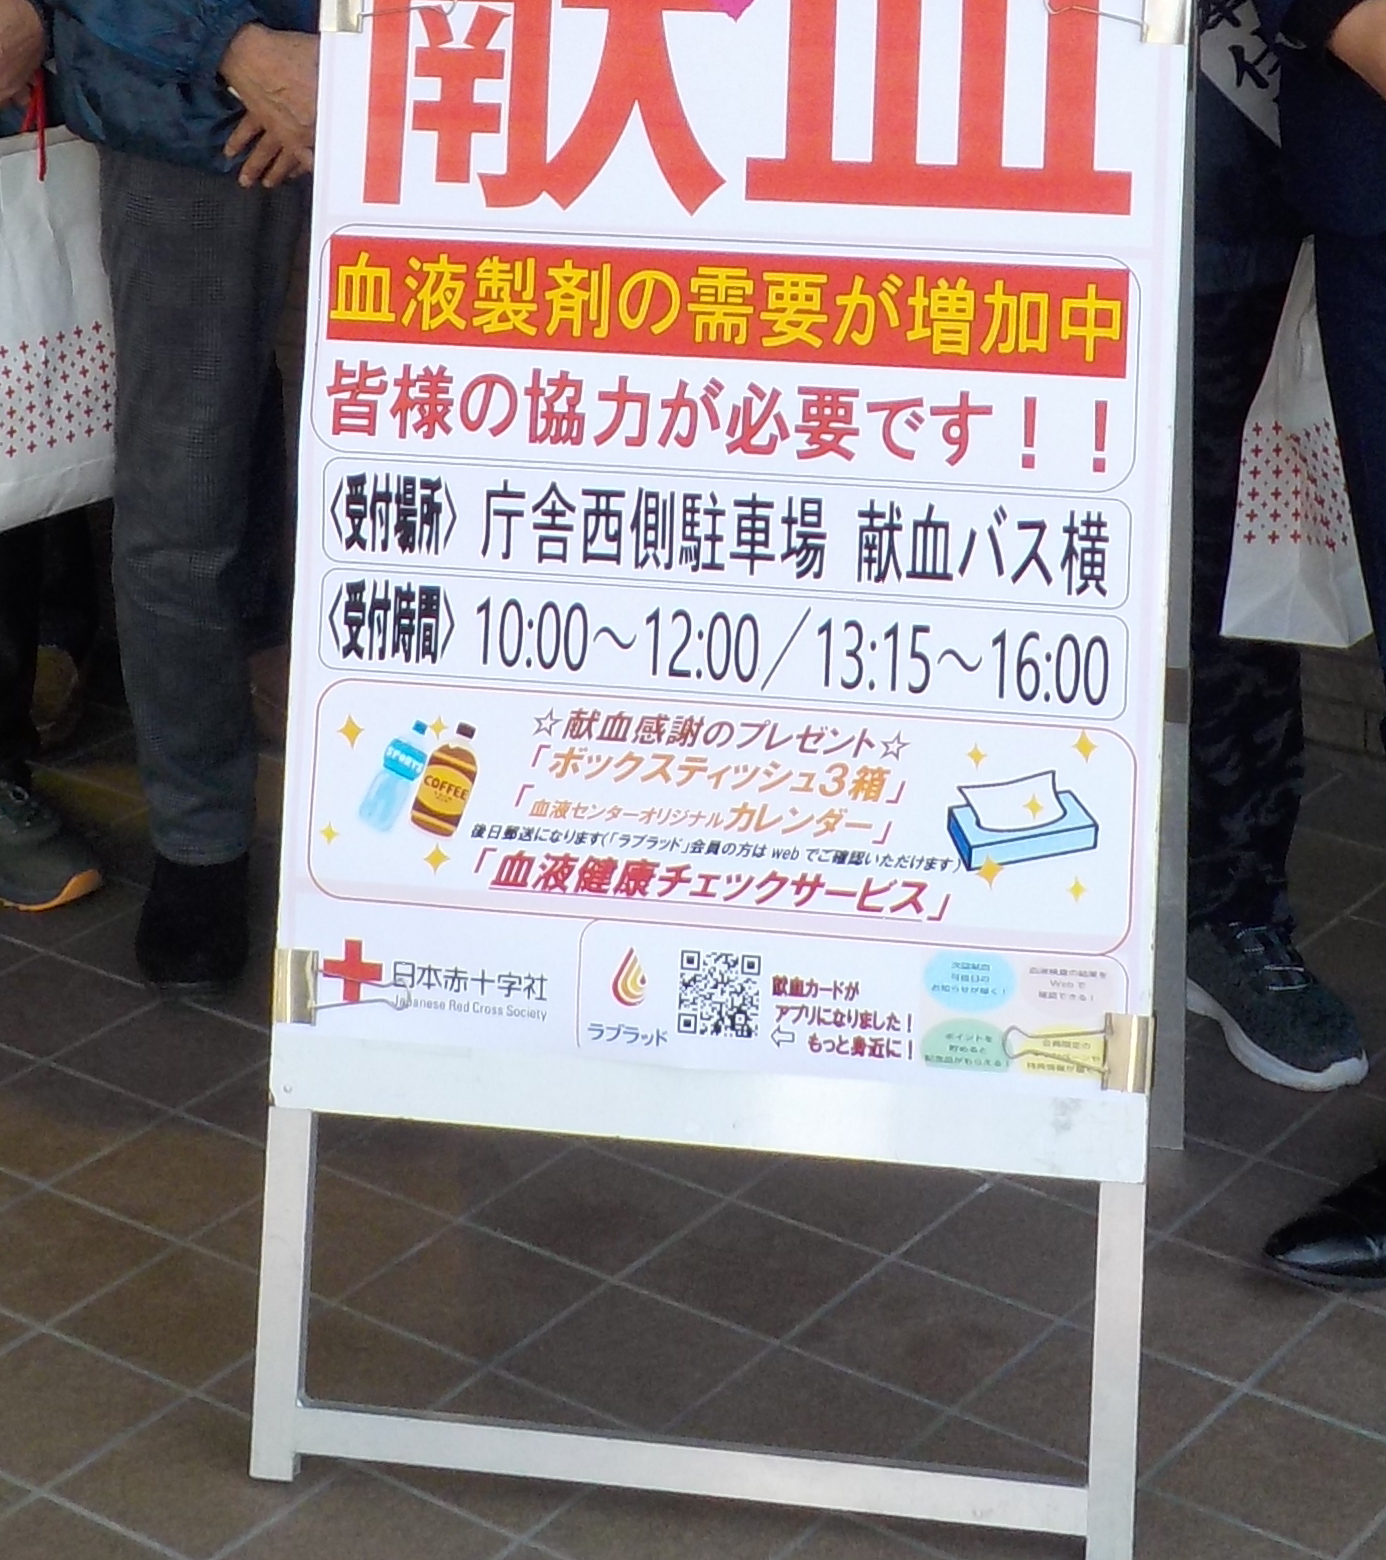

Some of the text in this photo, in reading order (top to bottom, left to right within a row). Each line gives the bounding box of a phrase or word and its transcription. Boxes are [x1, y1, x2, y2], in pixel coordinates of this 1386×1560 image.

[329, 252, 1124, 363] 血液製剤の需要が増加中
[326, 359, 1110, 473] 皆様の協力が必要です！！
[481, 480, 827, 581] 庁舎西側駐車場
[855, 497, 1111, 598] 献血バス横
[423, 774, 471, 802] COFFEE
[771, 845, 801, 861] web
[392, 960, 549, 1002] 日本赤十字社
[448, 999, 471, 1014] Red
[472, 1001, 504, 1017] Cross
[506, 1005, 548, 1023] Society
[774, 1003, 913, 1034] アプリになりました！
[586, 1022, 669, 1048] ラブラッド
[807, 1031, 915, 1061] もっと身近に！
